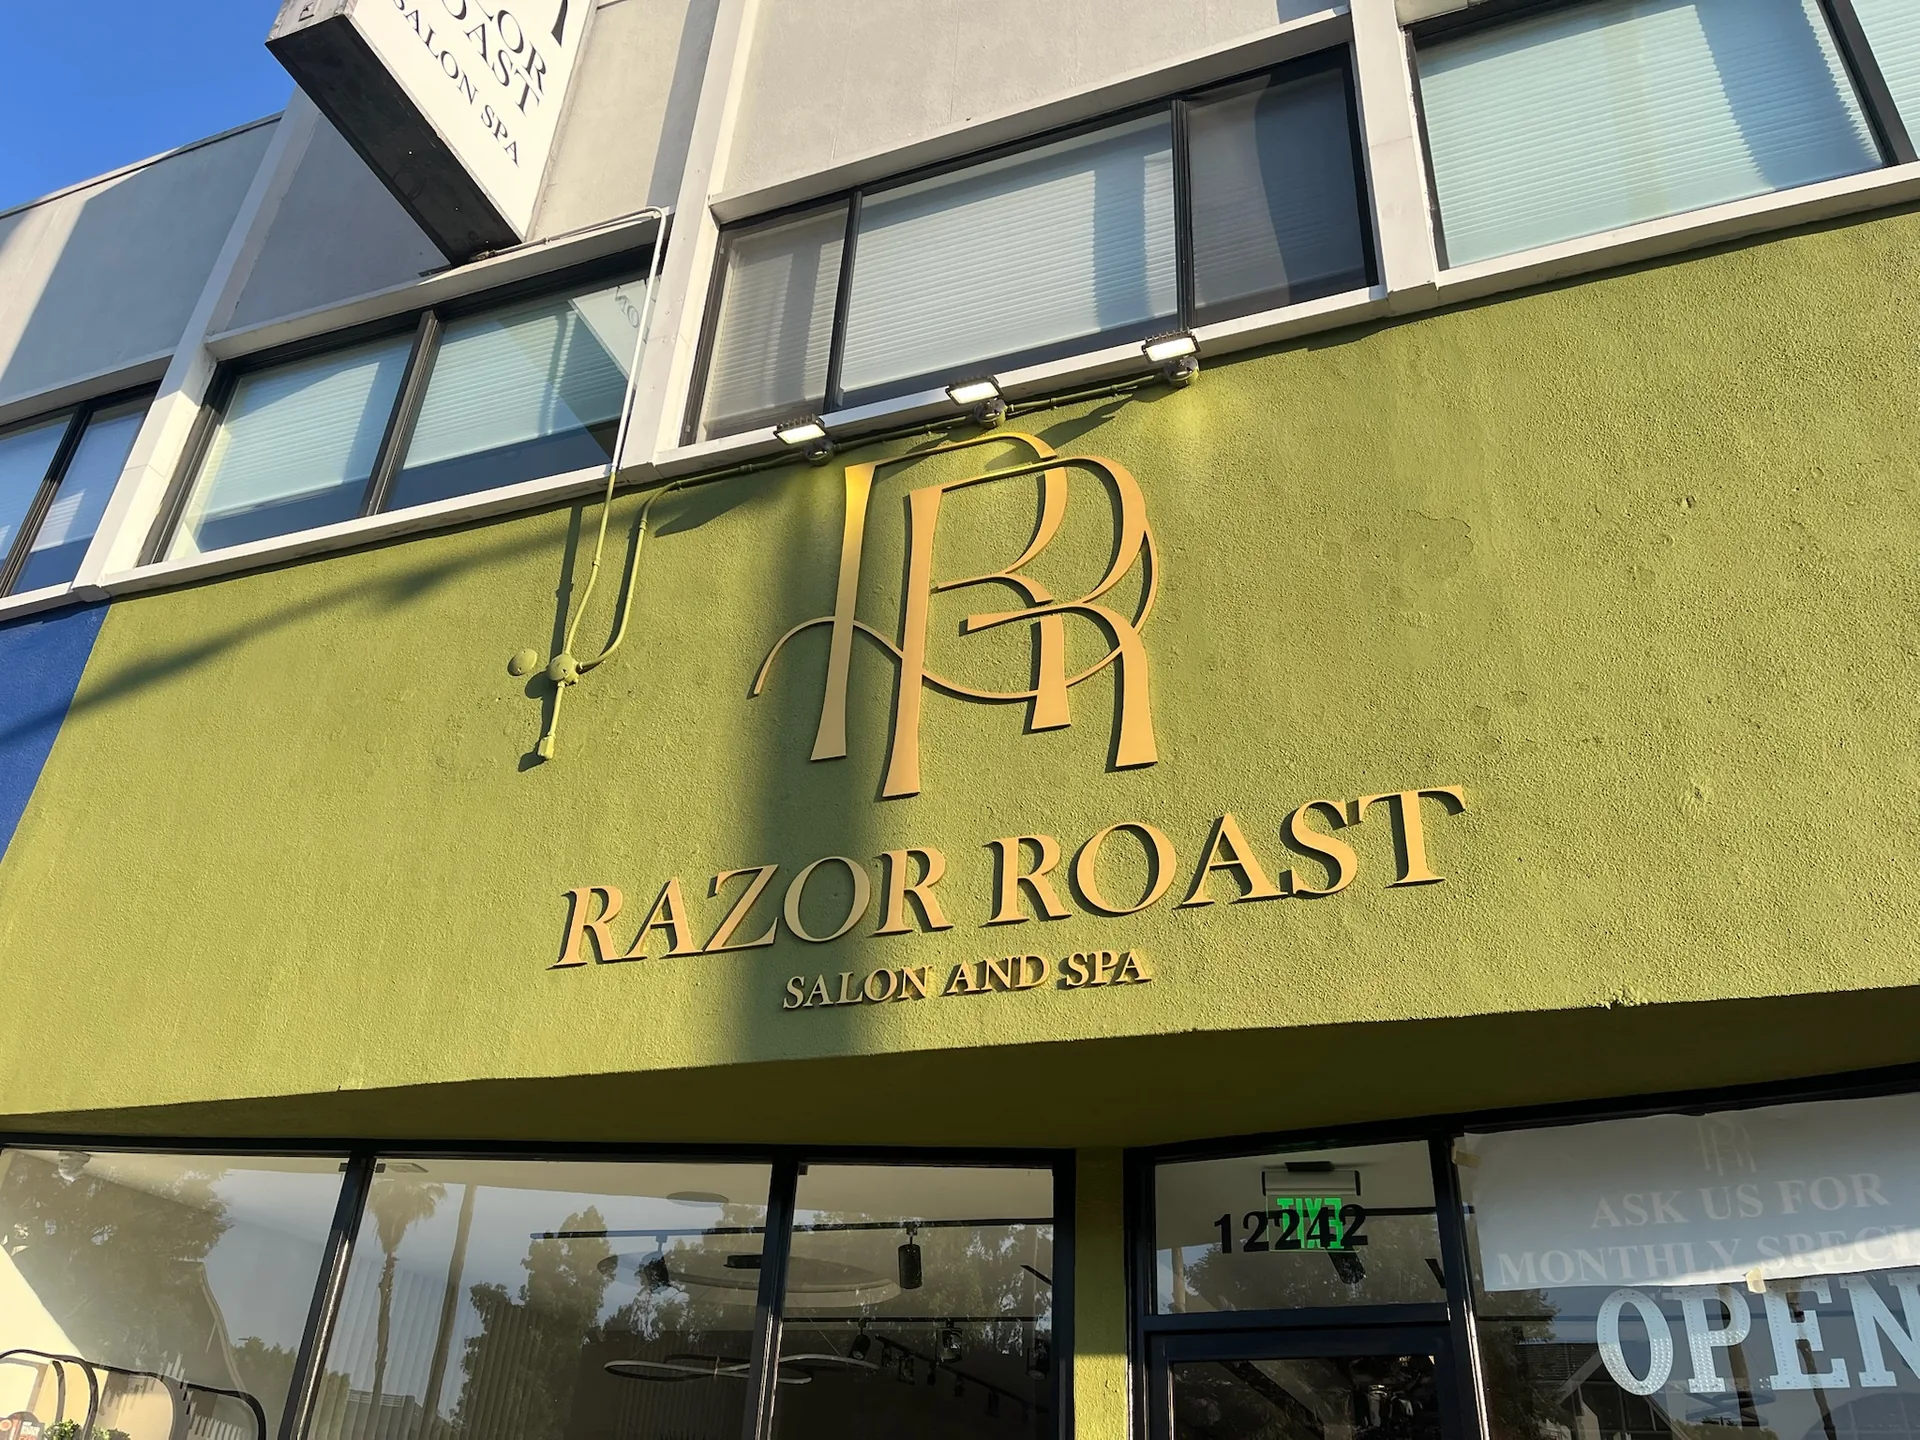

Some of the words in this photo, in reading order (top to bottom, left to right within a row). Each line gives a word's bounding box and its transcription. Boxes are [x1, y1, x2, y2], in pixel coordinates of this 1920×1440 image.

[481, 104, 519, 168] SPA
[550, 846, 954, 969] RAZOR
[983, 784, 1466, 926] ROAST
[783, 965, 932, 1010] SALON
[945, 953, 1051, 997] AND
[1066, 947, 1152, 988] SPA
[1214, 1203, 1368, 1254] 12242
[1591, 1190, 1690, 1228] ASK
[1701, 1182, 1764, 1220] US
[1776, 1172, 1891, 1214] FOR
[1497, 1238, 1743, 1286] MONTHLY
[1596, 1272, 1920, 1396] OPEN
